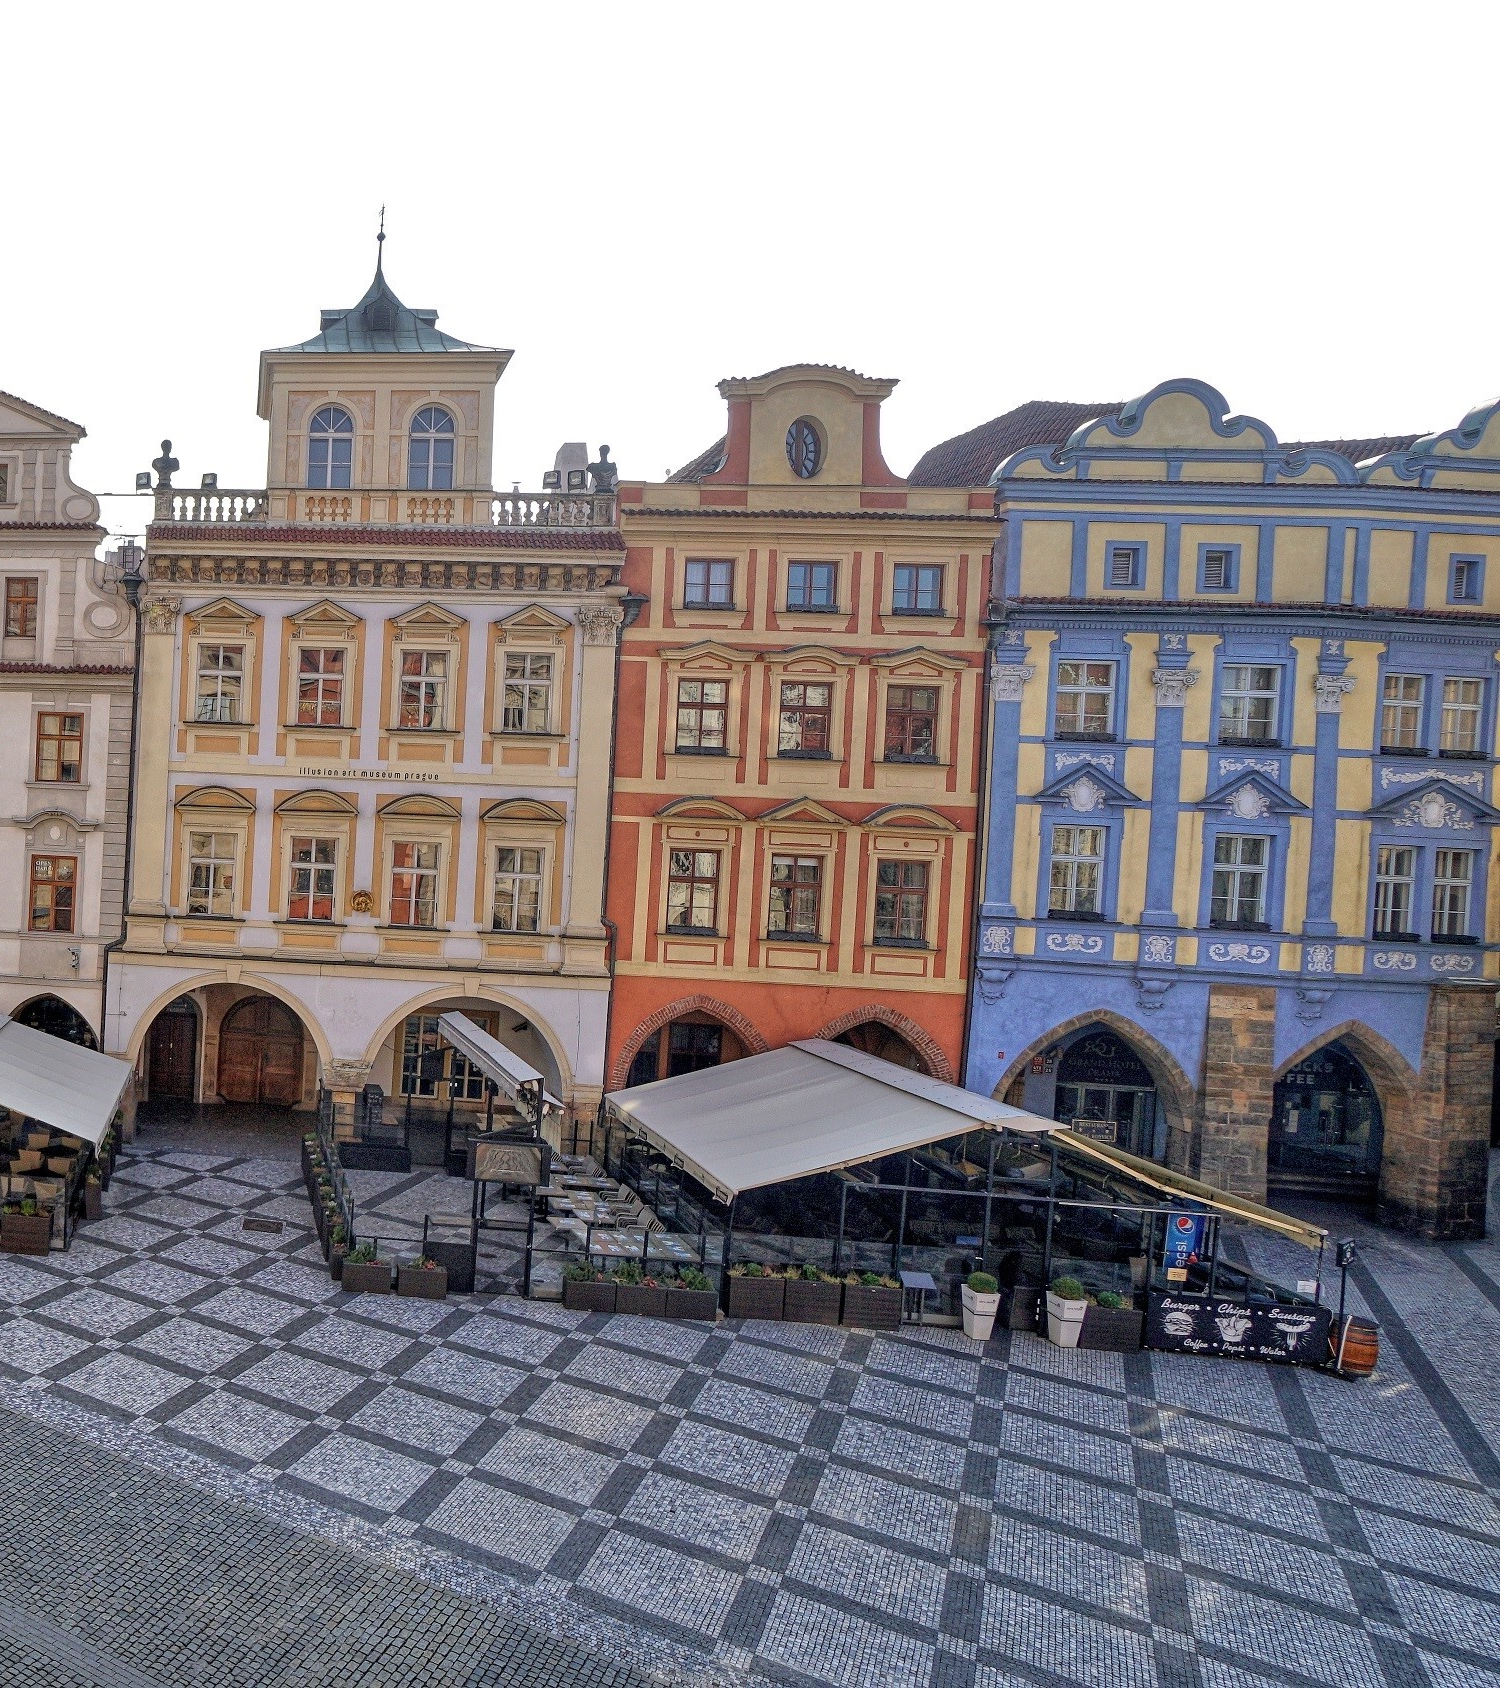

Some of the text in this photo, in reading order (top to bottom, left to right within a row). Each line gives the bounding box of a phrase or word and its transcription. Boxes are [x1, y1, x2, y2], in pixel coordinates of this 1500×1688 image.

[299, 767, 439, 782] illusion art museum prague
[1291, 1062, 1334, 1074] UCKS
[1175, 1241, 1188, 1267] epsi
[1161, 1298, 1317, 1323] Burger Chips Sausage
[1183, 1338, 1287, 1356] Coffee Pepsi Water
